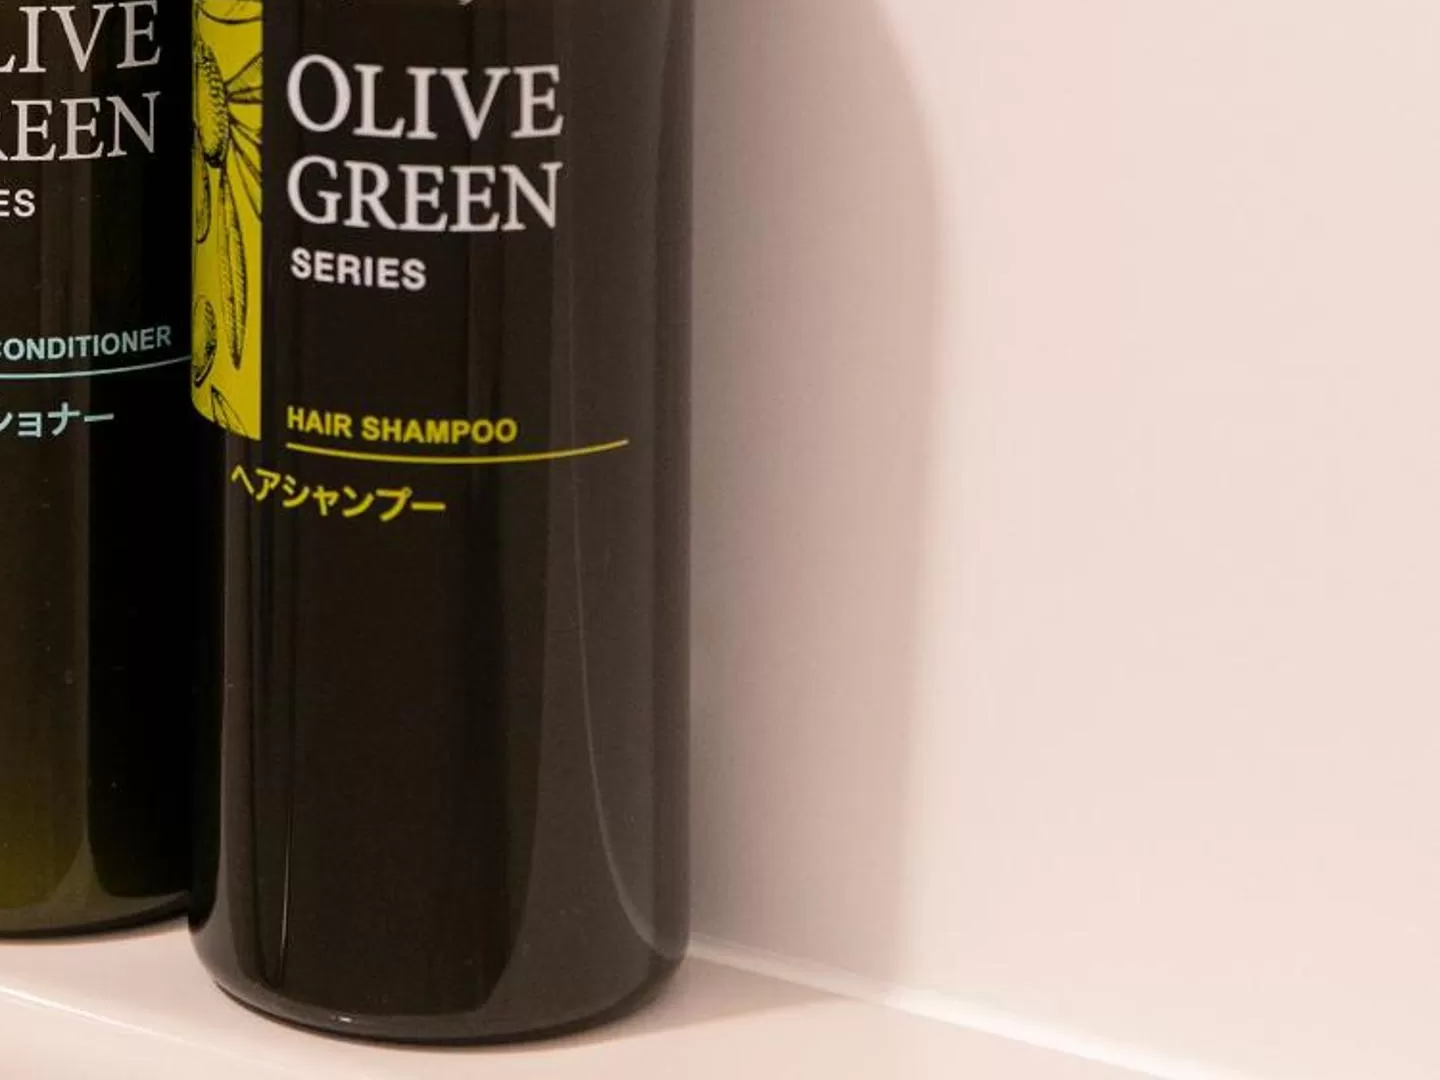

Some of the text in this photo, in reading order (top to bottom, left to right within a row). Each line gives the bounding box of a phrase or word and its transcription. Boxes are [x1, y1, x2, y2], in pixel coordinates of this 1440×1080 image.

[288, 55, 563, 140] OLIVE
[288, 156, 563, 232] GREEN
[291, 248, 426, 290] SERIES
[288, 407, 516, 443] HAIR SHAMPOO
[231, 464, 446, 522] ヘアシャンプー
